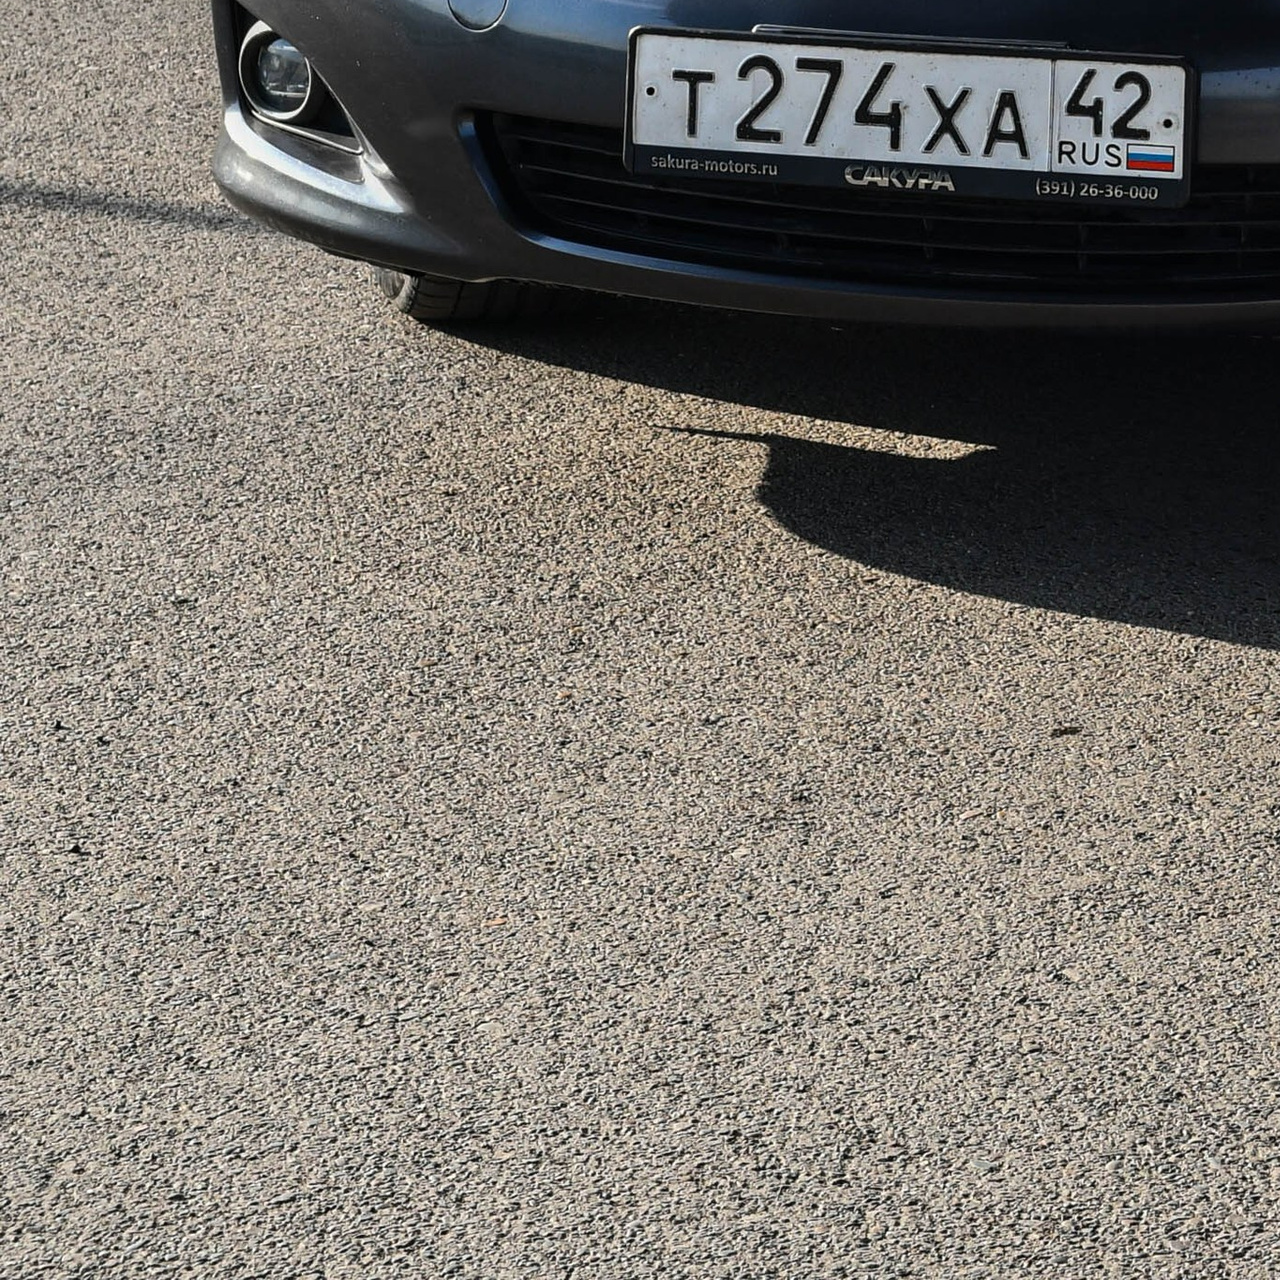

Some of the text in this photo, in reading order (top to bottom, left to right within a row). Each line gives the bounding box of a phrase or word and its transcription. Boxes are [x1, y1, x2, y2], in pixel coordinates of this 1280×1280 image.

[1064, 68, 1152, 141] 42
[651, 153, 779, 176] sakura-motors.ru
[1057, 140, 1122, 168] RUS
[844, 163, 956, 192] САКУРА
[1035, 178, 1159, 201] (391) 26-36-000
